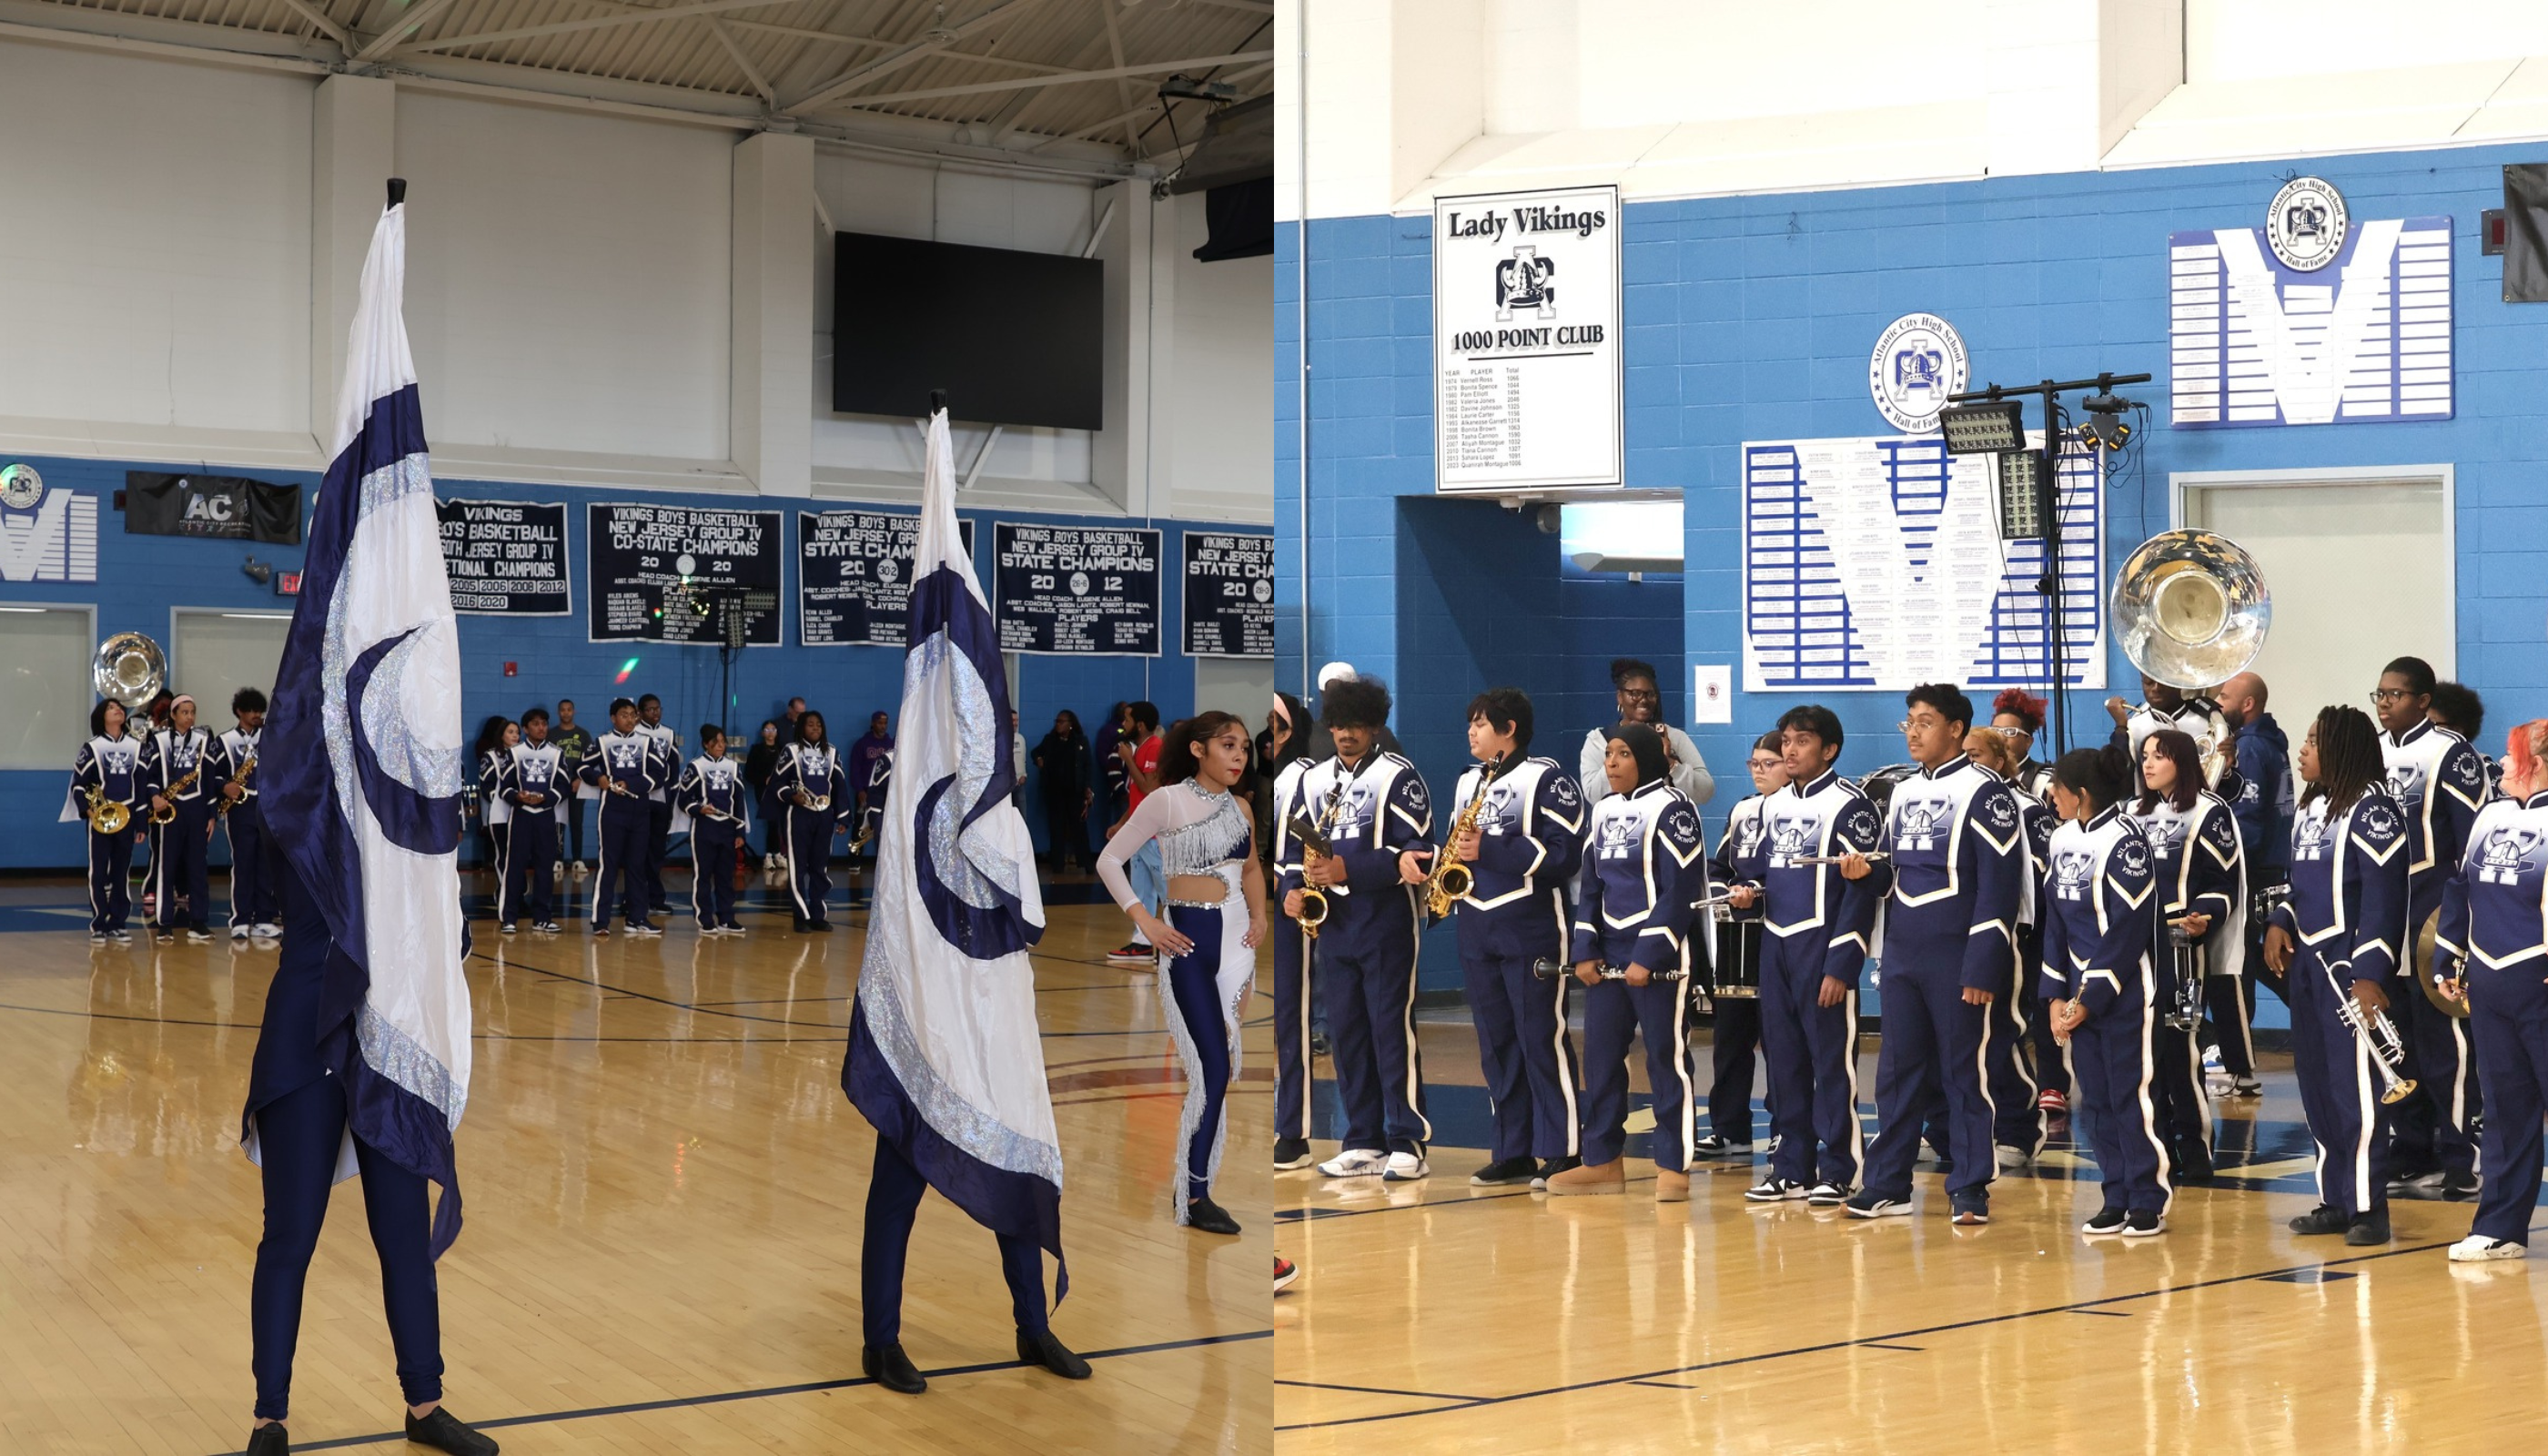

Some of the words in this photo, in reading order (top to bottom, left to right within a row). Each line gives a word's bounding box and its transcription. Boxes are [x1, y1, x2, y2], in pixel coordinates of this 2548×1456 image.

[2270, 188, 2290, 218] Atlantic
[2290, 181, 2306, 192] City
[2309, 180, 2326, 193] High
[2327, 190, 2343, 215] School
[1450, 209, 1508, 243] Lady
[1512, 205, 1605, 237] Vikings
[2286, 255, 2300, 268] Hall
[2310, 255, 2328, 268] Fame
[1454, 330, 1493, 350] 1000
[1498, 328, 1552, 348] POINT
[1557, 325, 1603, 345] CLUB
[1875, 328, 1898, 365] Atlantic
[1899, 318, 1918, 330] City
[1922, 317, 1943, 332] High
[1943, 329, 1964, 362] School
[1893, 413, 1910, 429] Hall
[1912, 420, 1920, 430] of
[1924, 415, 1940, 428] Fam
[184, 493, 232, 521] AC
[613, 508, 653, 521] VIKINGS
[657, 511, 685, 525] BOYS
[690, 513, 758, 528] BASKETBALL
[817, 515, 854, 528] VIKINGS
[859, 516, 885, 529] BOYS
[469, 524, 558, 541] BASKETBALL
[610, 521, 636, 533] NEW
[642, 524, 695, 538] JERSEY
[700, 527, 744, 540] GROUP
[750, 529, 763, 541] IV
[814, 529, 841, 541] NEW
[844, 530, 894, 543] JERSEY
[1016, 528, 1050, 541] VIKINGS
[1054, 531, 1078, 543] BOYS
[1083, 532, 1143, 544] BASKETBALL
[466, 542, 501, 558] JERSEY
[506, 544, 537, 559] GROUP
[542, 544, 553, 560] IV
[613, 534, 678, 552] CO-STATE
[682, 539, 758, 556] CHAMPIONS
[804, 541, 863, 557] STATE
[864, 543, 915, 560] CHAM
[1012, 541, 1036, 553] NEW
[1038, 544, 1086, 556] JERSEY
[1090, 545, 1127, 557] GROUP
[1132, 546, 1145, 557] IV
[1203, 537, 1235, 549] VIKINGS
[1239, 539, 1260, 551] BOYS
[641, 556, 659, 567] 20
[1001, 553, 1054, 570] STATE
[1059, 557, 1154, 571] CHAMPIONS
[1198, 549, 1220, 561] NEW
[1225, 551, 1269, 563] JERSEY
[494, 561, 555, 577] CHAMPIONS
[713, 561, 732, 571] 20
[840, 561, 864, 575] 20
[1189, 561, 1240, 577] STATE
[1245, 564, 1274, 578] CHA
[451, 580, 476, 591] 2005
[480, 581, 506, 592] 2006
[539, 581, 563, 592] 2012
[1031, 575, 1055, 590] 20
[1104, 577, 1123, 591] 12
[1223, 582, 1247, 596] 20
[451, 595, 476, 606] 2016
[480, 597, 506, 607] 2020
[866, 601, 907, 611] PLAYERS
[2389, 812, 2399, 826] CITY
[2367, 829, 2394, 840] VIKINGS
[2117, 840, 2143, 859] ATLANTIC
[2122, 865, 2148, 877] VIKINGS
